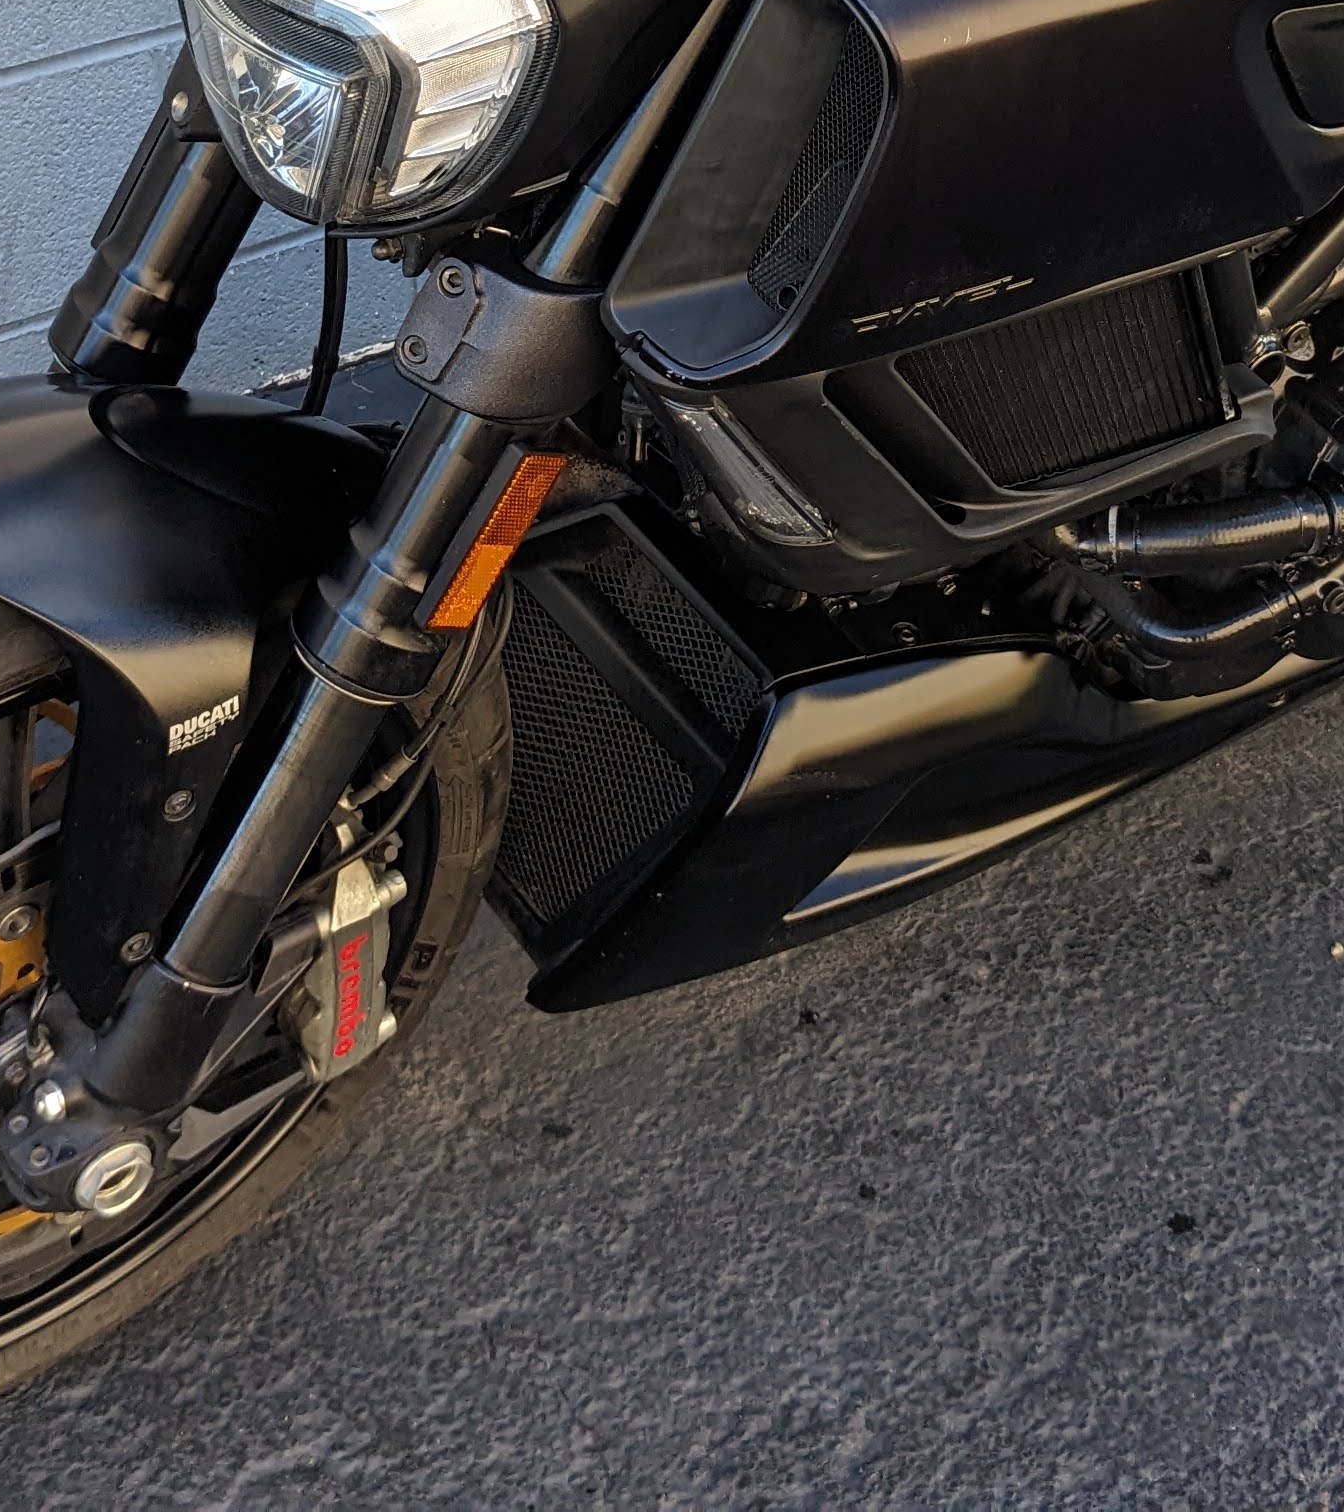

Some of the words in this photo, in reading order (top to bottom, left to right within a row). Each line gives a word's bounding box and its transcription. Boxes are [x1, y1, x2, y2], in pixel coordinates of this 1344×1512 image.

[168, 710, 240, 748] SAFETY
[169, 694, 240, 740] DUCATI
[167, 730, 216, 756] PACK
[333, 933, 368, 1058] brembo
